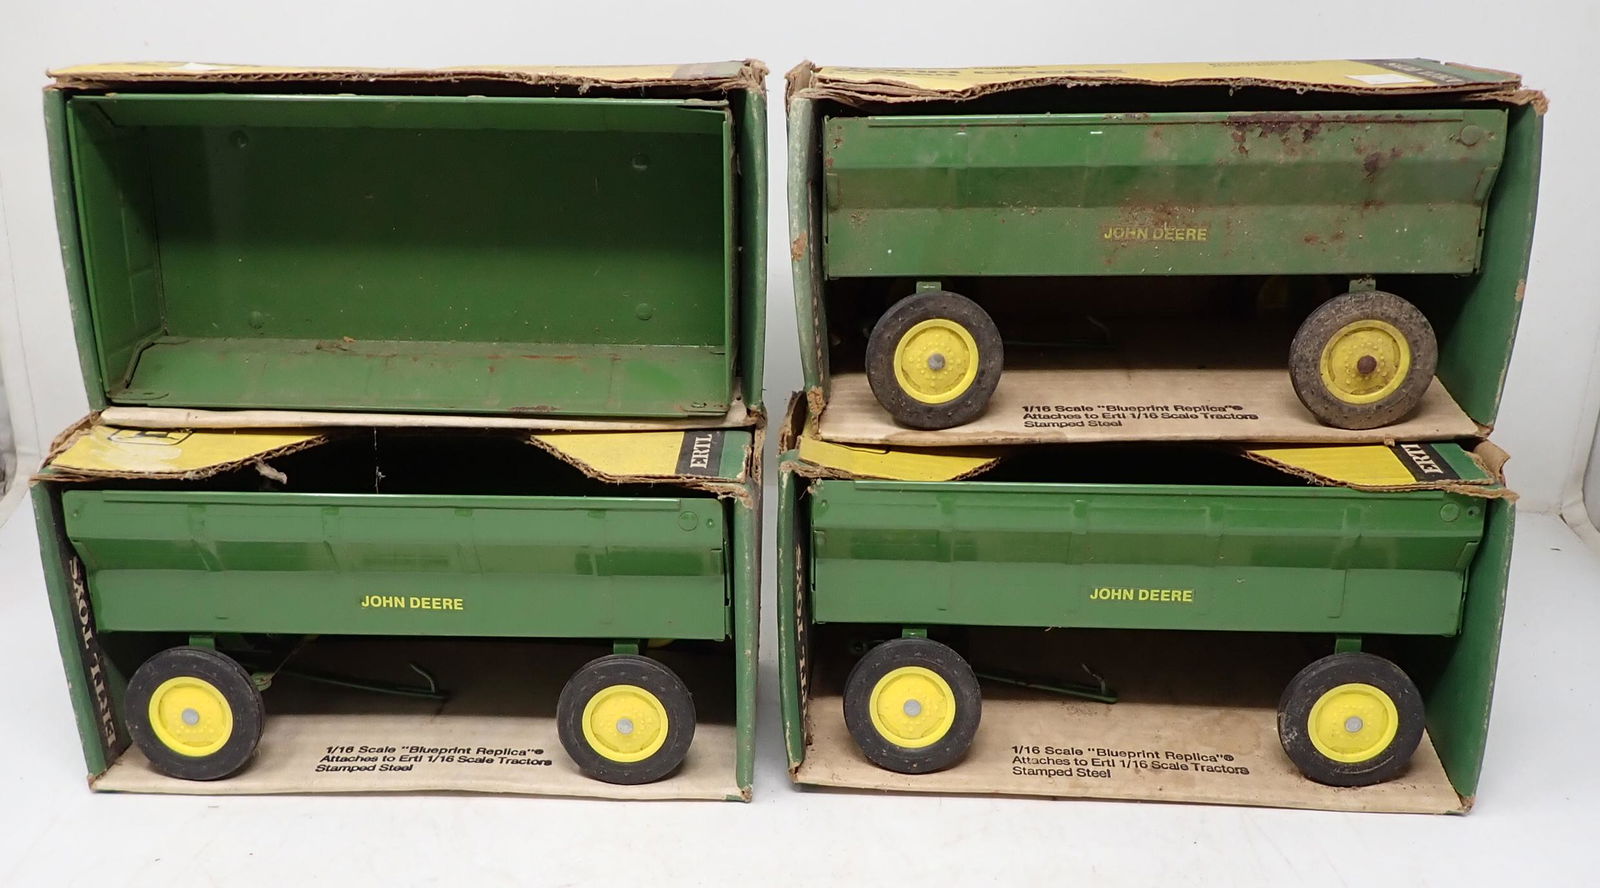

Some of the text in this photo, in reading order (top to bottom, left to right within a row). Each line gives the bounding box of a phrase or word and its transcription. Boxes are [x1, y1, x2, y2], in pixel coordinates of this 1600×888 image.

[1104, 227, 1208, 241] JOHN DEERE
[1023, 412, 1260, 421] Attaches to Ertl 1/16 Scale Tractors
[1023, 420, 1123, 428] Stamped Steel
[690, 434, 712, 469] ERTL
[1090, 588, 1193, 602] JOHN DEERE
[361, 595, 464, 610] JOHN DEERE
[90, 652, 117, 749] ERTL
[326, 746, 354, 754] 1/16
[358, 746, 396, 754] Scale
[1011, 745, 1040, 755] 1/16
[1044, 746, 1083, 756] Scale
[319, 754, 552, 766] Attaches to Ertl 1/16 Scale Tractors
[1012, 755, 1250, 775] Attaches to Ertl 1/16 Scale Tractors
[315, 764, 414, 773] Stamped Steel
[1012, 766, 1112, 778] Stamped Steel
